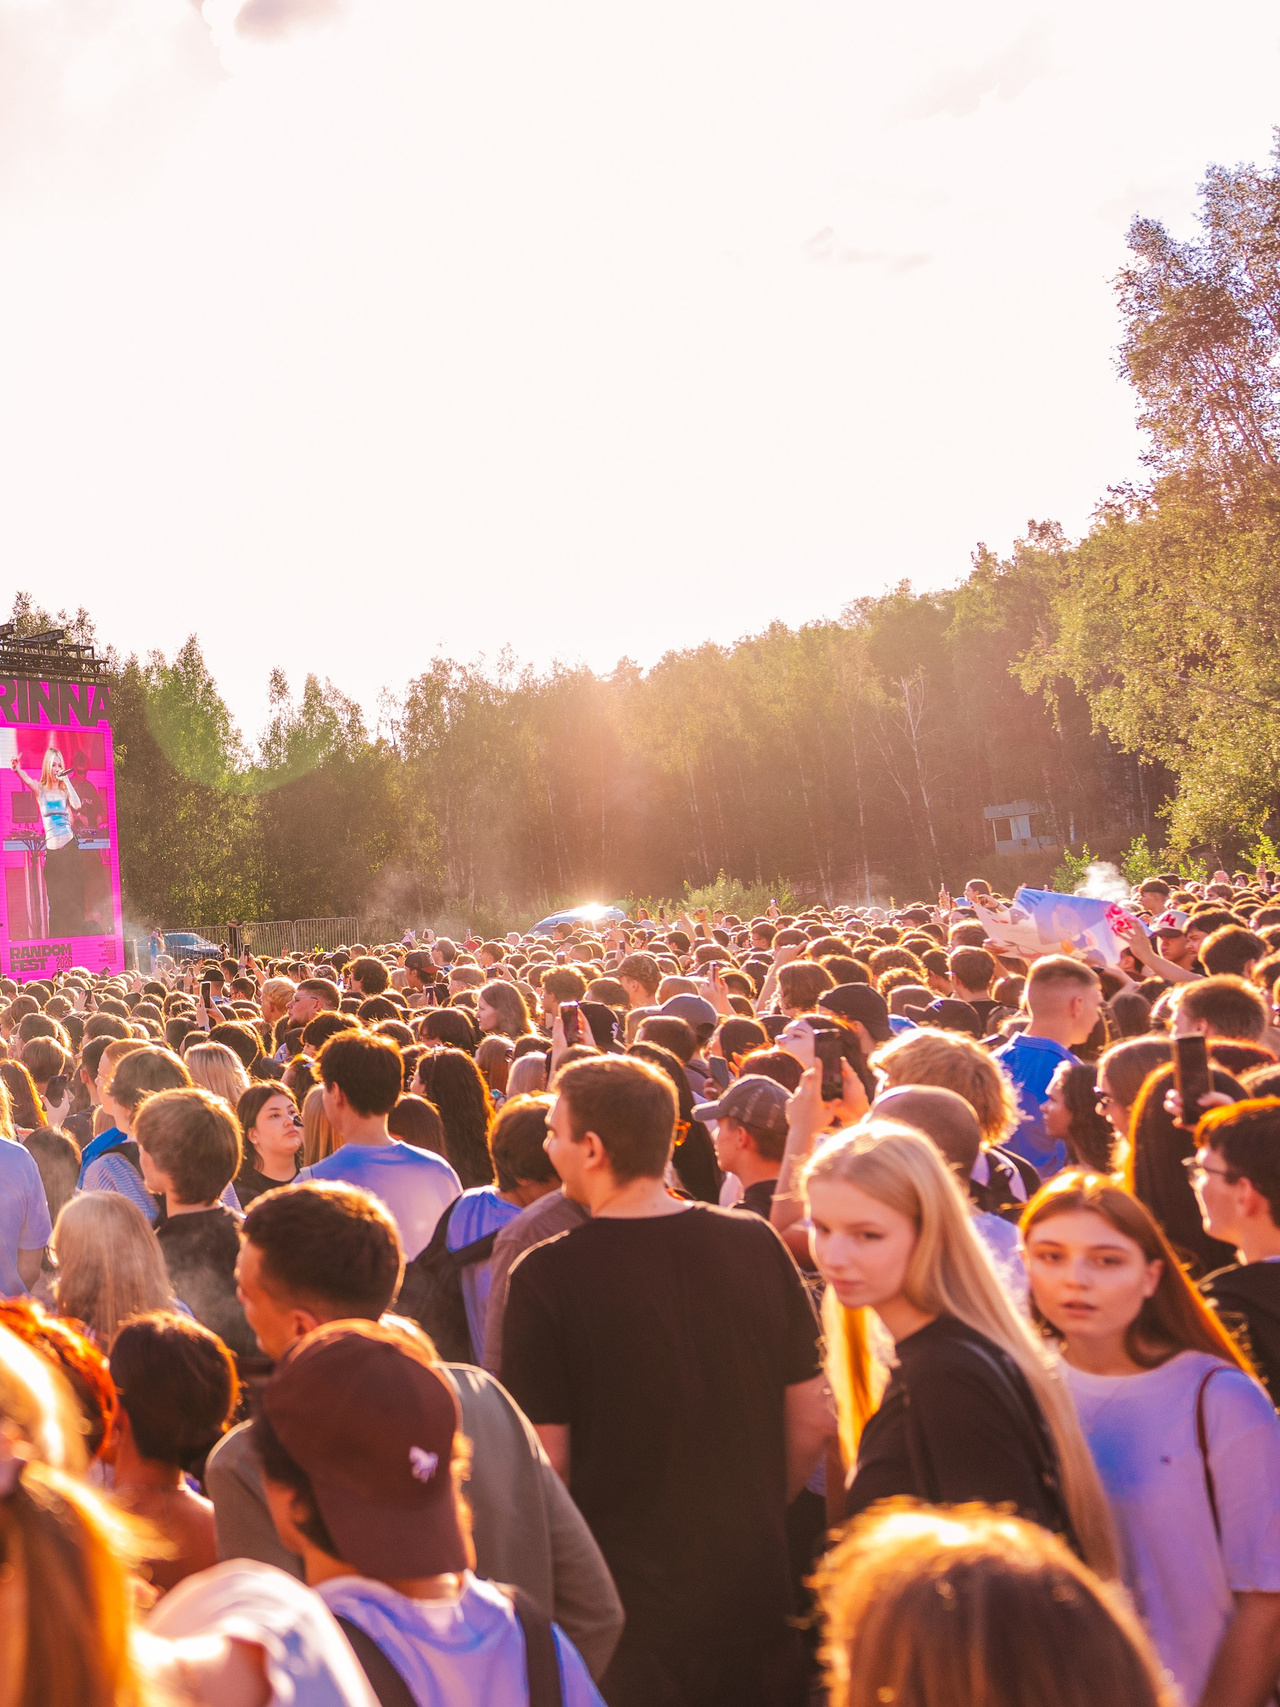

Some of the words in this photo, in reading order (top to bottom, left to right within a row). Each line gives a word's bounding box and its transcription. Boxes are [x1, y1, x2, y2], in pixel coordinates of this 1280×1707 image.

[10, 943, 72, 959] RANDOM
[10, 958, 48, 973] FEST
[56, 956, 73, 969] 2026
